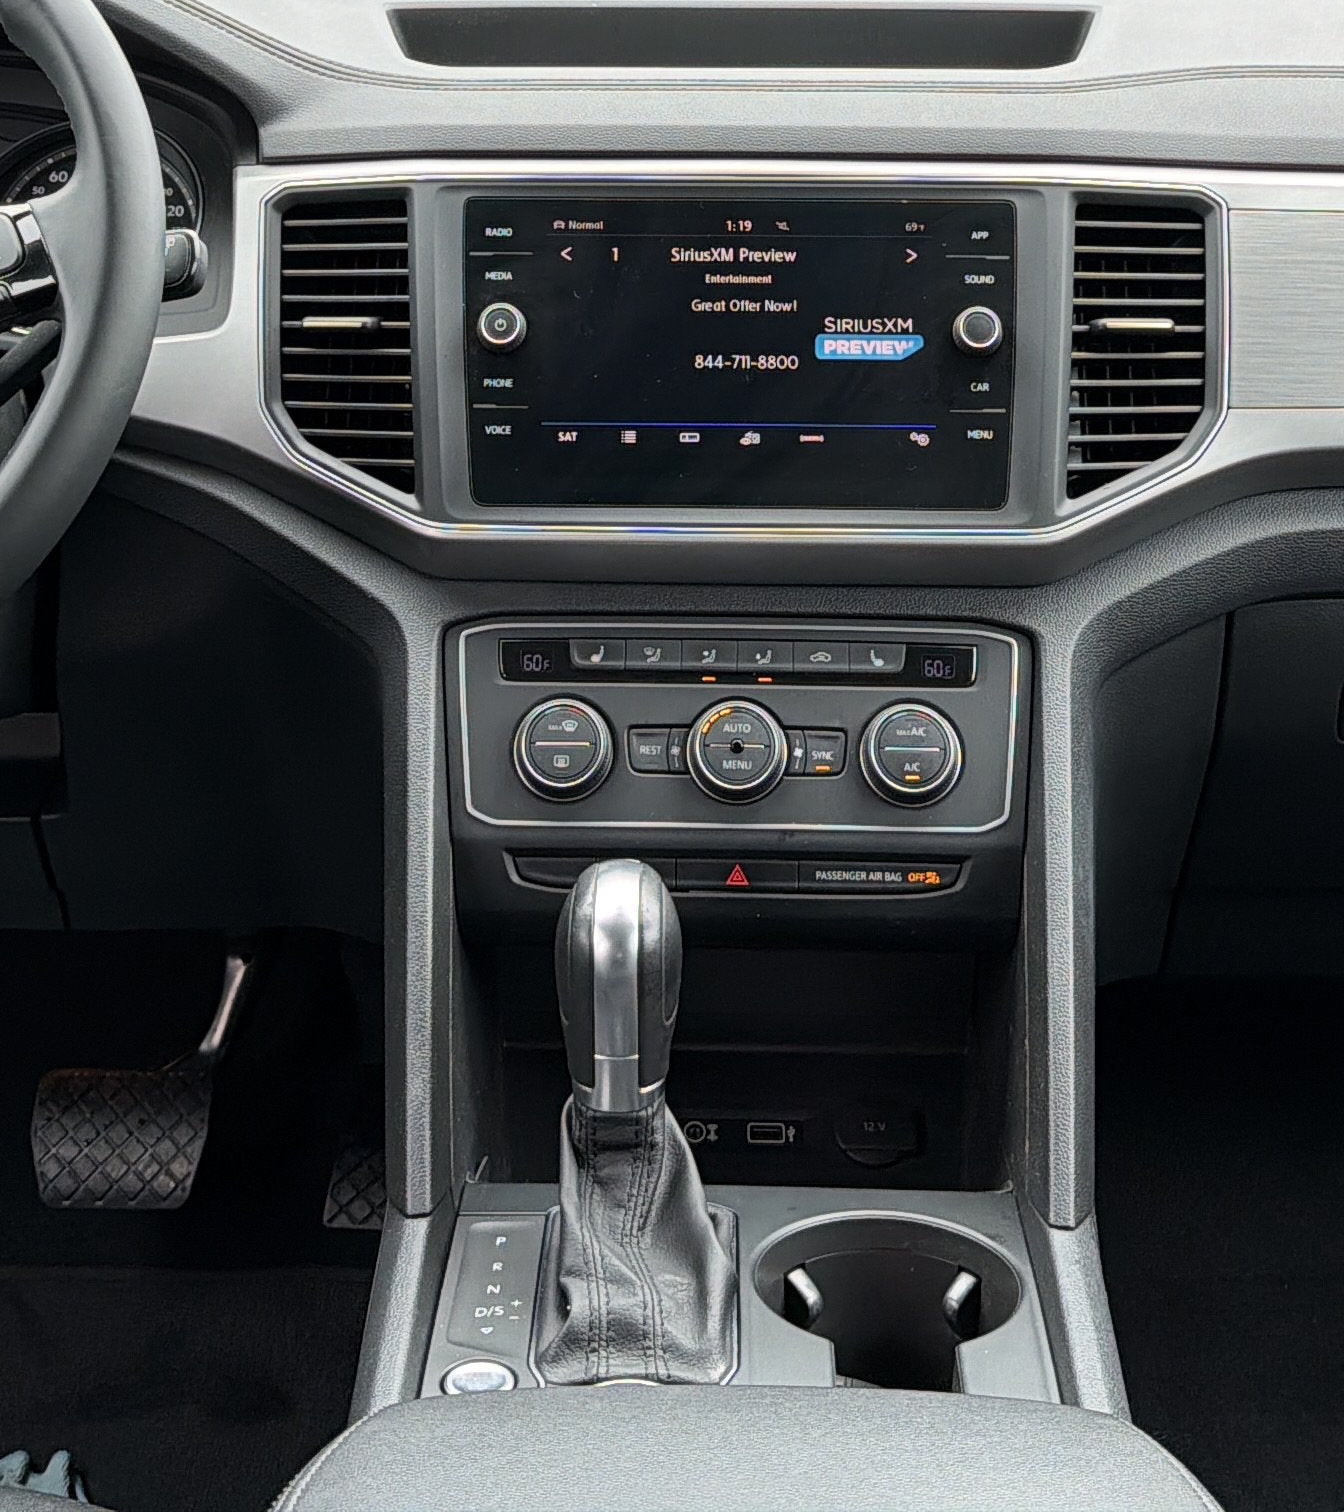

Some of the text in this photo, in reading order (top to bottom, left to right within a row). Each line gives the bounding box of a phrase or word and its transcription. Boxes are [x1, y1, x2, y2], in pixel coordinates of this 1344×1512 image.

[49, 170, 68, 183] 60
[31, 185, 45, 196] 50
[167, 205, 185, 218] 20
[568, 220, 604, 230] Normal
[726, 220, 753, 232] 1:19
[485, 227, 513, 237] RADIO
[971, 230, 989, 240] APP
[611, 247, 619, 262] 1
[670, 247, 797, 263] SiriusXM Preview
[485, 271, 513, 281] MEDIA
[705, 273, 772, 284] Entertainment
[964, 274, 995, 285] SOUND
[691, 298, 798, 312] Great Offer Now!
[824, 316, 913, 333] SIRIUSXM
[823, 339, 913, 355] PREVIEW
[694, 354, 799, 370] 844-711-8800
[483, 378, 513, 388] PHONE
[970, 381, 990, 392] CAR
[485, 425, 512, 435] VOICE
[967, 429, 994, 440] MENU
[558, 431, 578, 442] SAT
[722, 723, 751, 734] AUTO
[911, 726, 927, 737] A/C
[639, 745, 662, 755] REST
[811, 750, 834, 762] SYNC
[722, 759, 752, 770] MENU
[904, 762, 920, 772] A/C
[816, 870, 925, 882] PASSENGER AIR BAG OFF
[864, 1121, 886, 1132] 12 V
[495, 1236, 507, 1247] P
[492, 1262, 503, 1272] R
[486, 1284, 501, 1295] N
[474, 1305, 505, 1318] D/S
